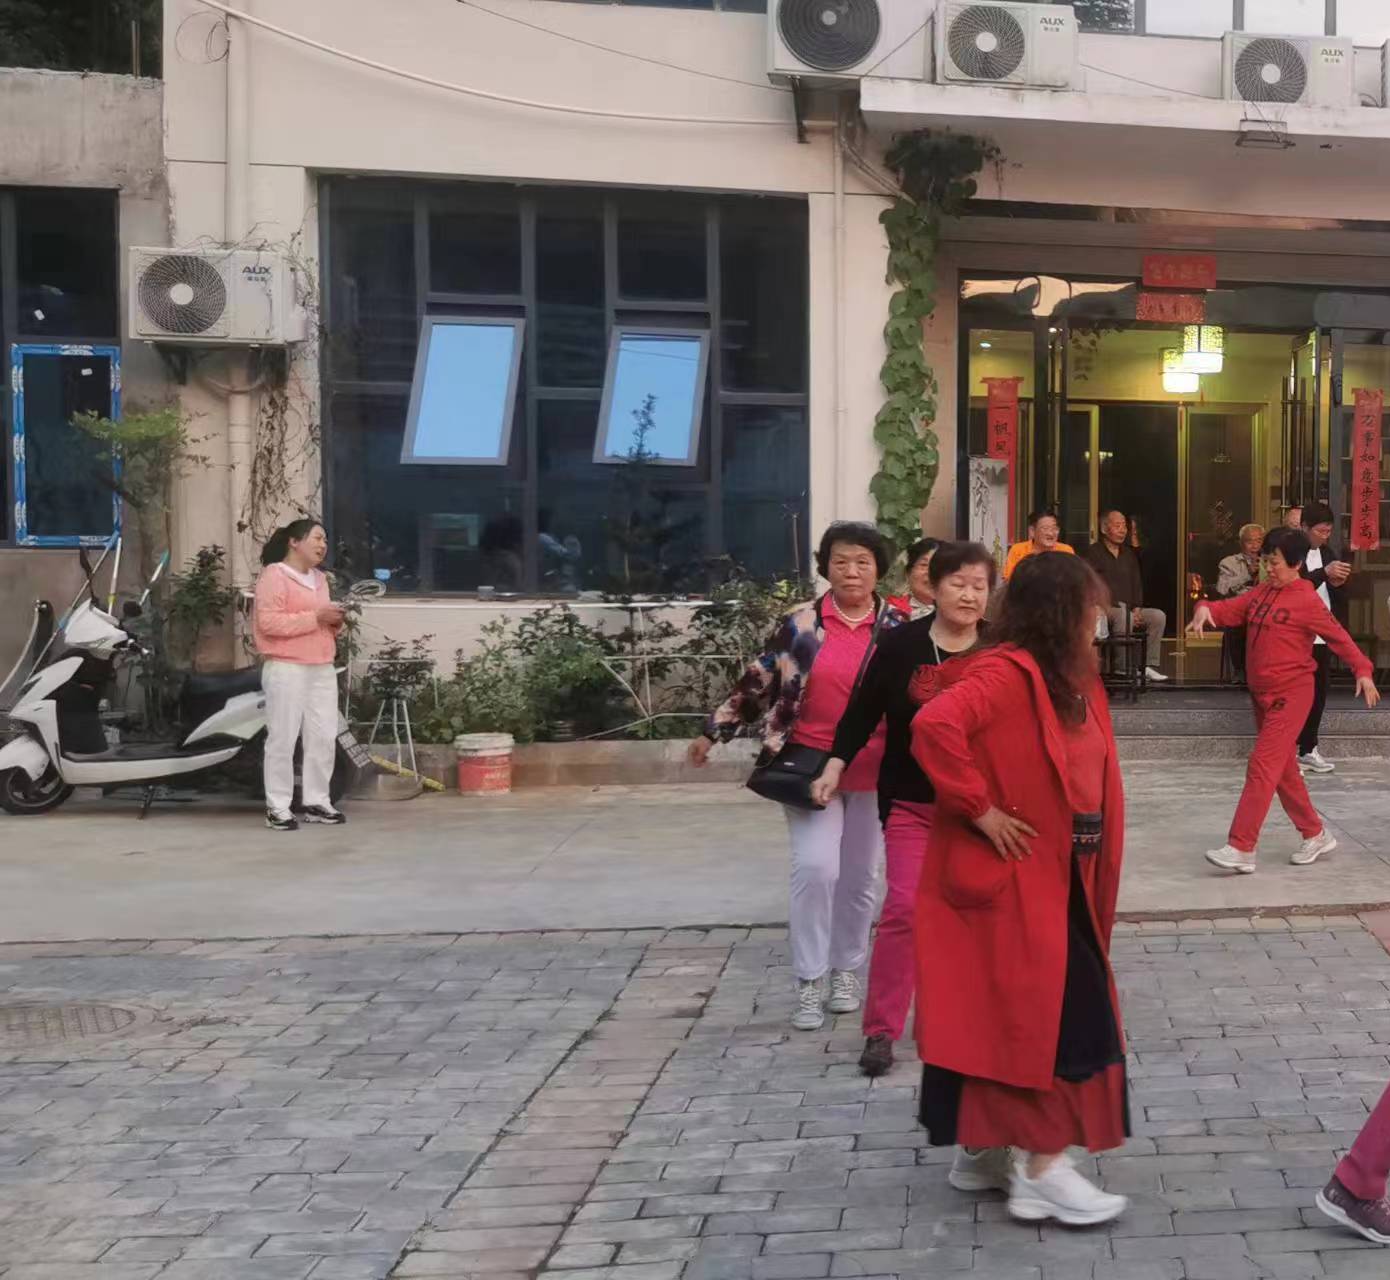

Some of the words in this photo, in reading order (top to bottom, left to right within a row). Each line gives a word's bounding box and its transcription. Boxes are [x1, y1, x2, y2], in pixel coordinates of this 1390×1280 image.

[1040, 17, 1064, 26] AUX
[1321, 48, 1344, 56] AUX
[242, 265, 271, 274] AUX
[1359, 414, 1376, 540] 万事如意步步高
